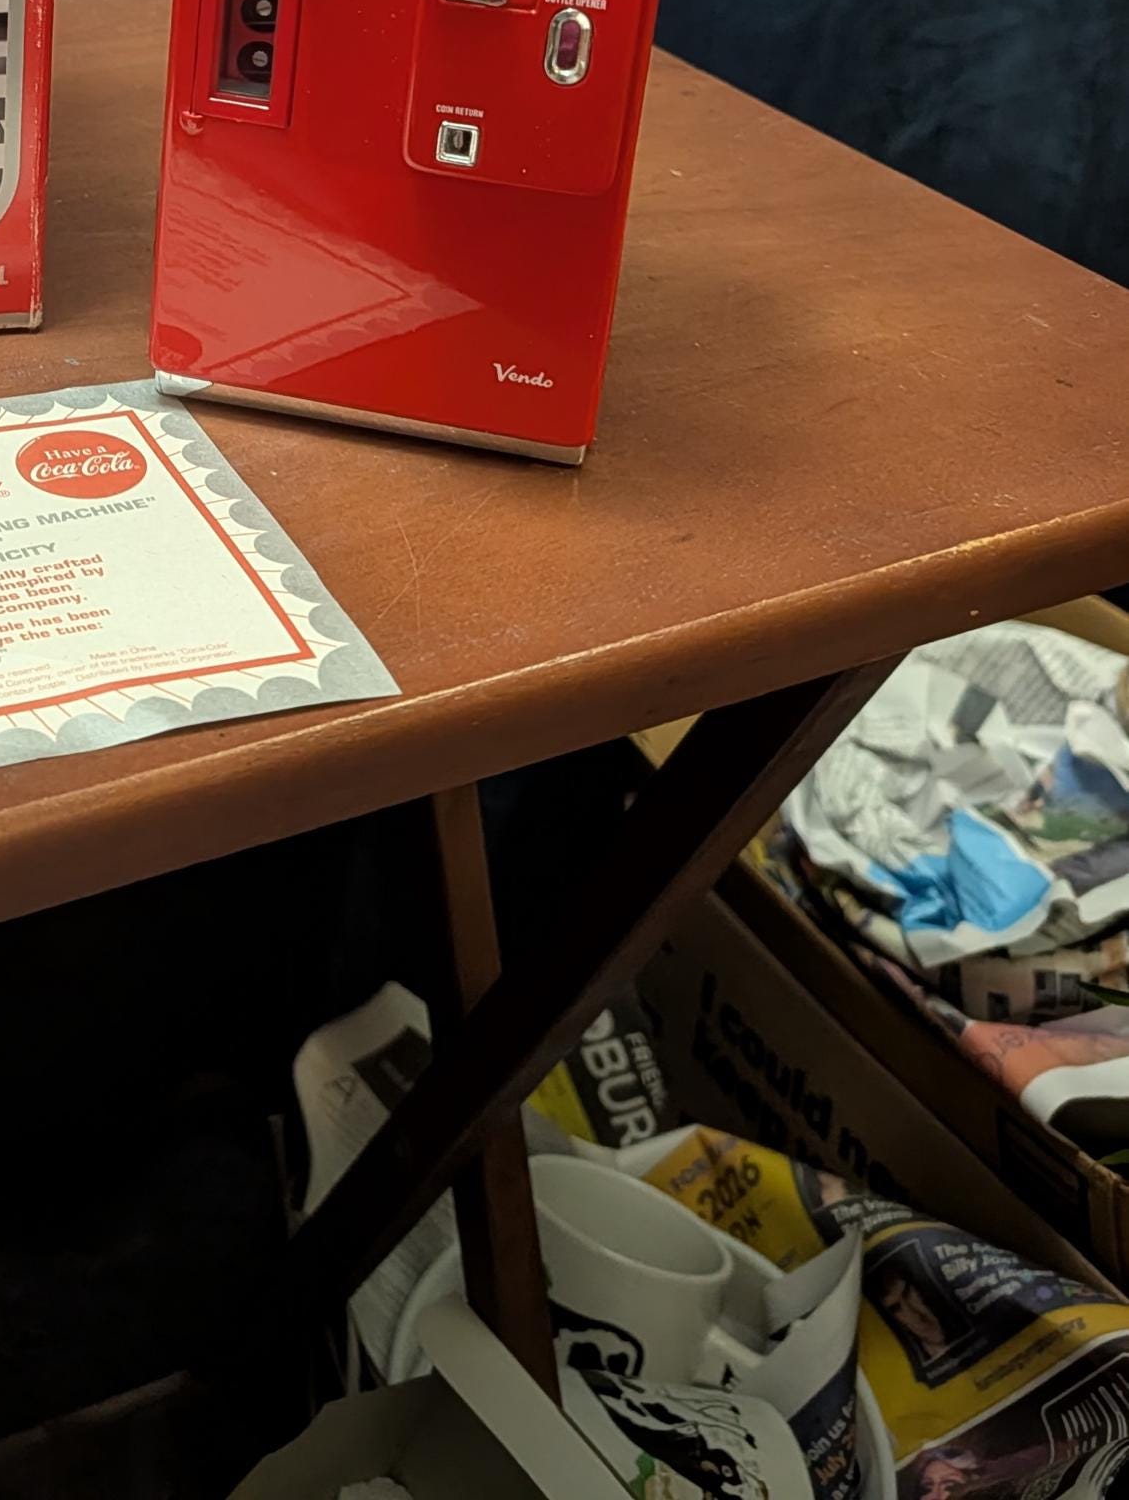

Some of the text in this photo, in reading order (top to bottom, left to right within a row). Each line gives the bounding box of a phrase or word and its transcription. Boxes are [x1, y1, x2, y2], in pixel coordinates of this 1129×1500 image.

[436, 105, 483, 117] COIN RETURN
[493, 363, 553, 389] Vendo
[45, 447, 92, 460] Have
[31, 451, 133, 482] Coca-Cola
[32, 554, 103, 574] crafted
[81, 567, 104, 577] by
[26, 583, 72, 597] been
[30, 614, 62, 628] has
[67, 607, 110, 622] been
[19, 629, 50, 641] the
[56, 622, 103, 635] tune:
